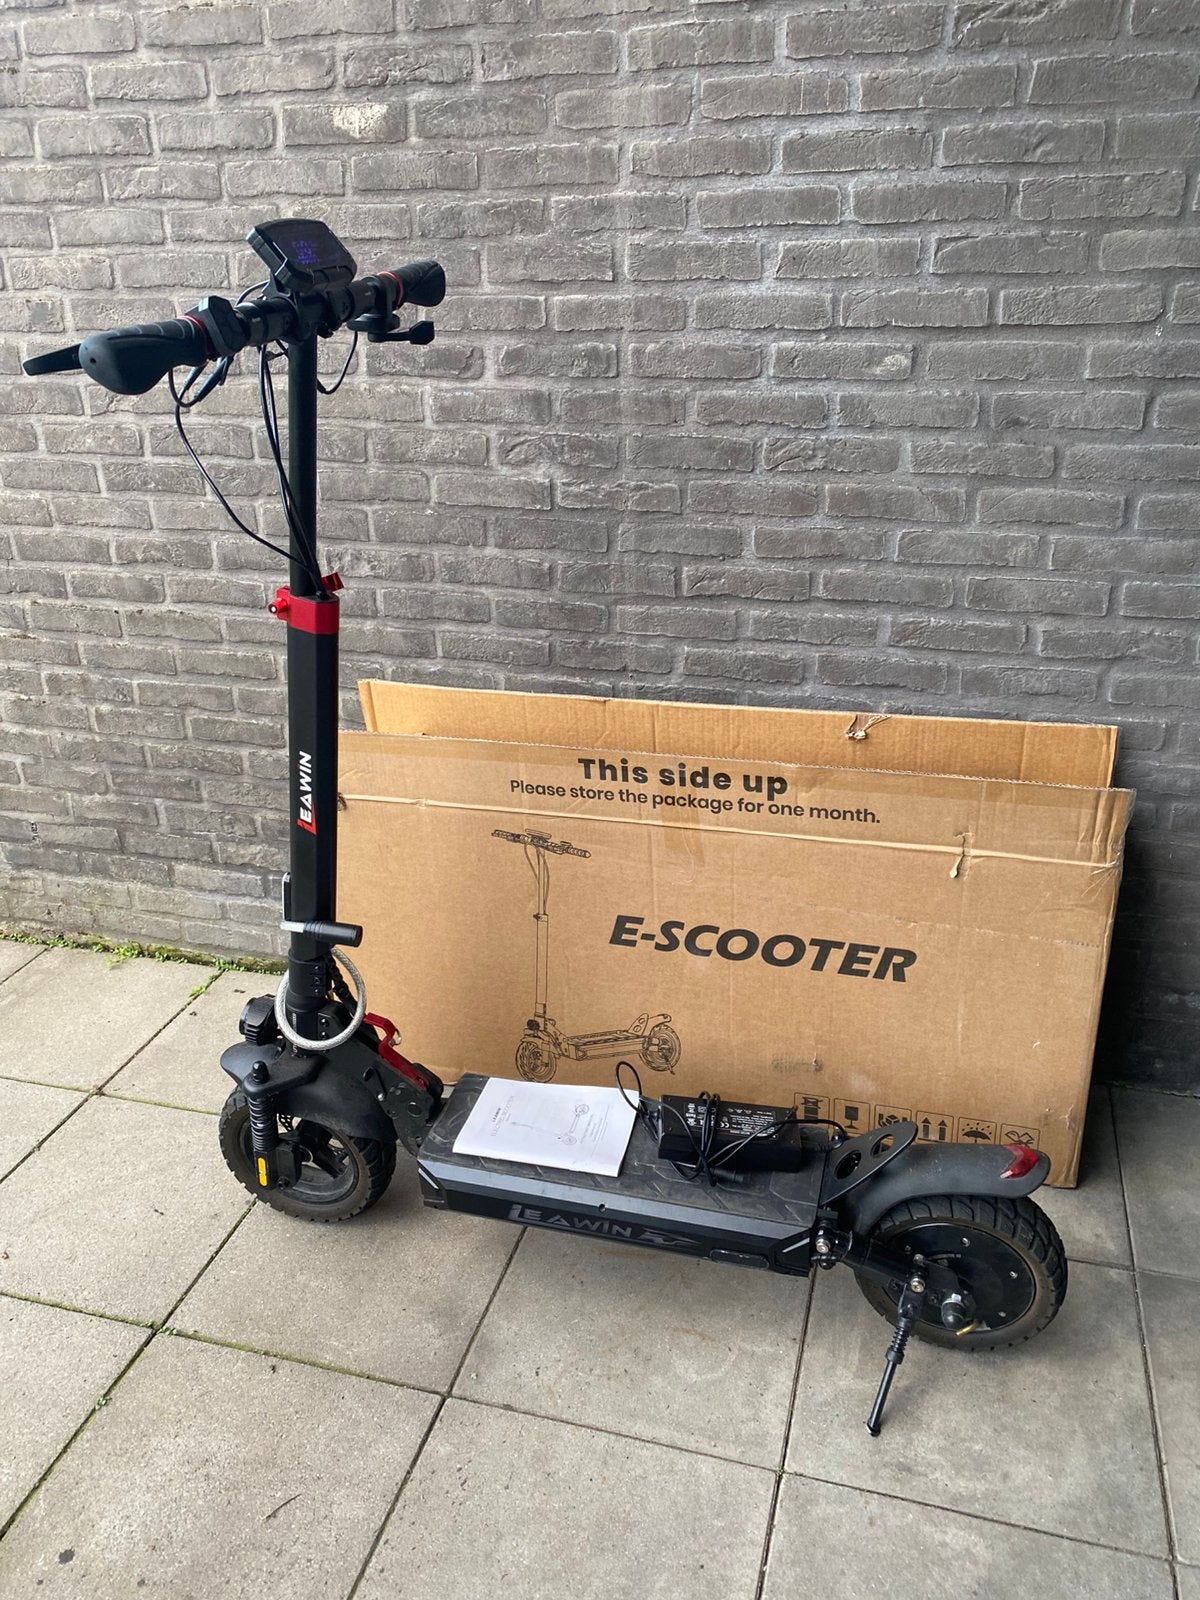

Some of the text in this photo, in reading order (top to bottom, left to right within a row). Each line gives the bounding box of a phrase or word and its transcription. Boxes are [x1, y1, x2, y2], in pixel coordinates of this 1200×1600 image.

[297, 750, 317, 835] LEAWIN
[510, 779, 881, 824] Please store the package for one month.
[578, 758, 788, 802] This side up
[608, 914, 917, 983] E-SCOOTER
[509, 1204, 632, 1237] LEAWIN
